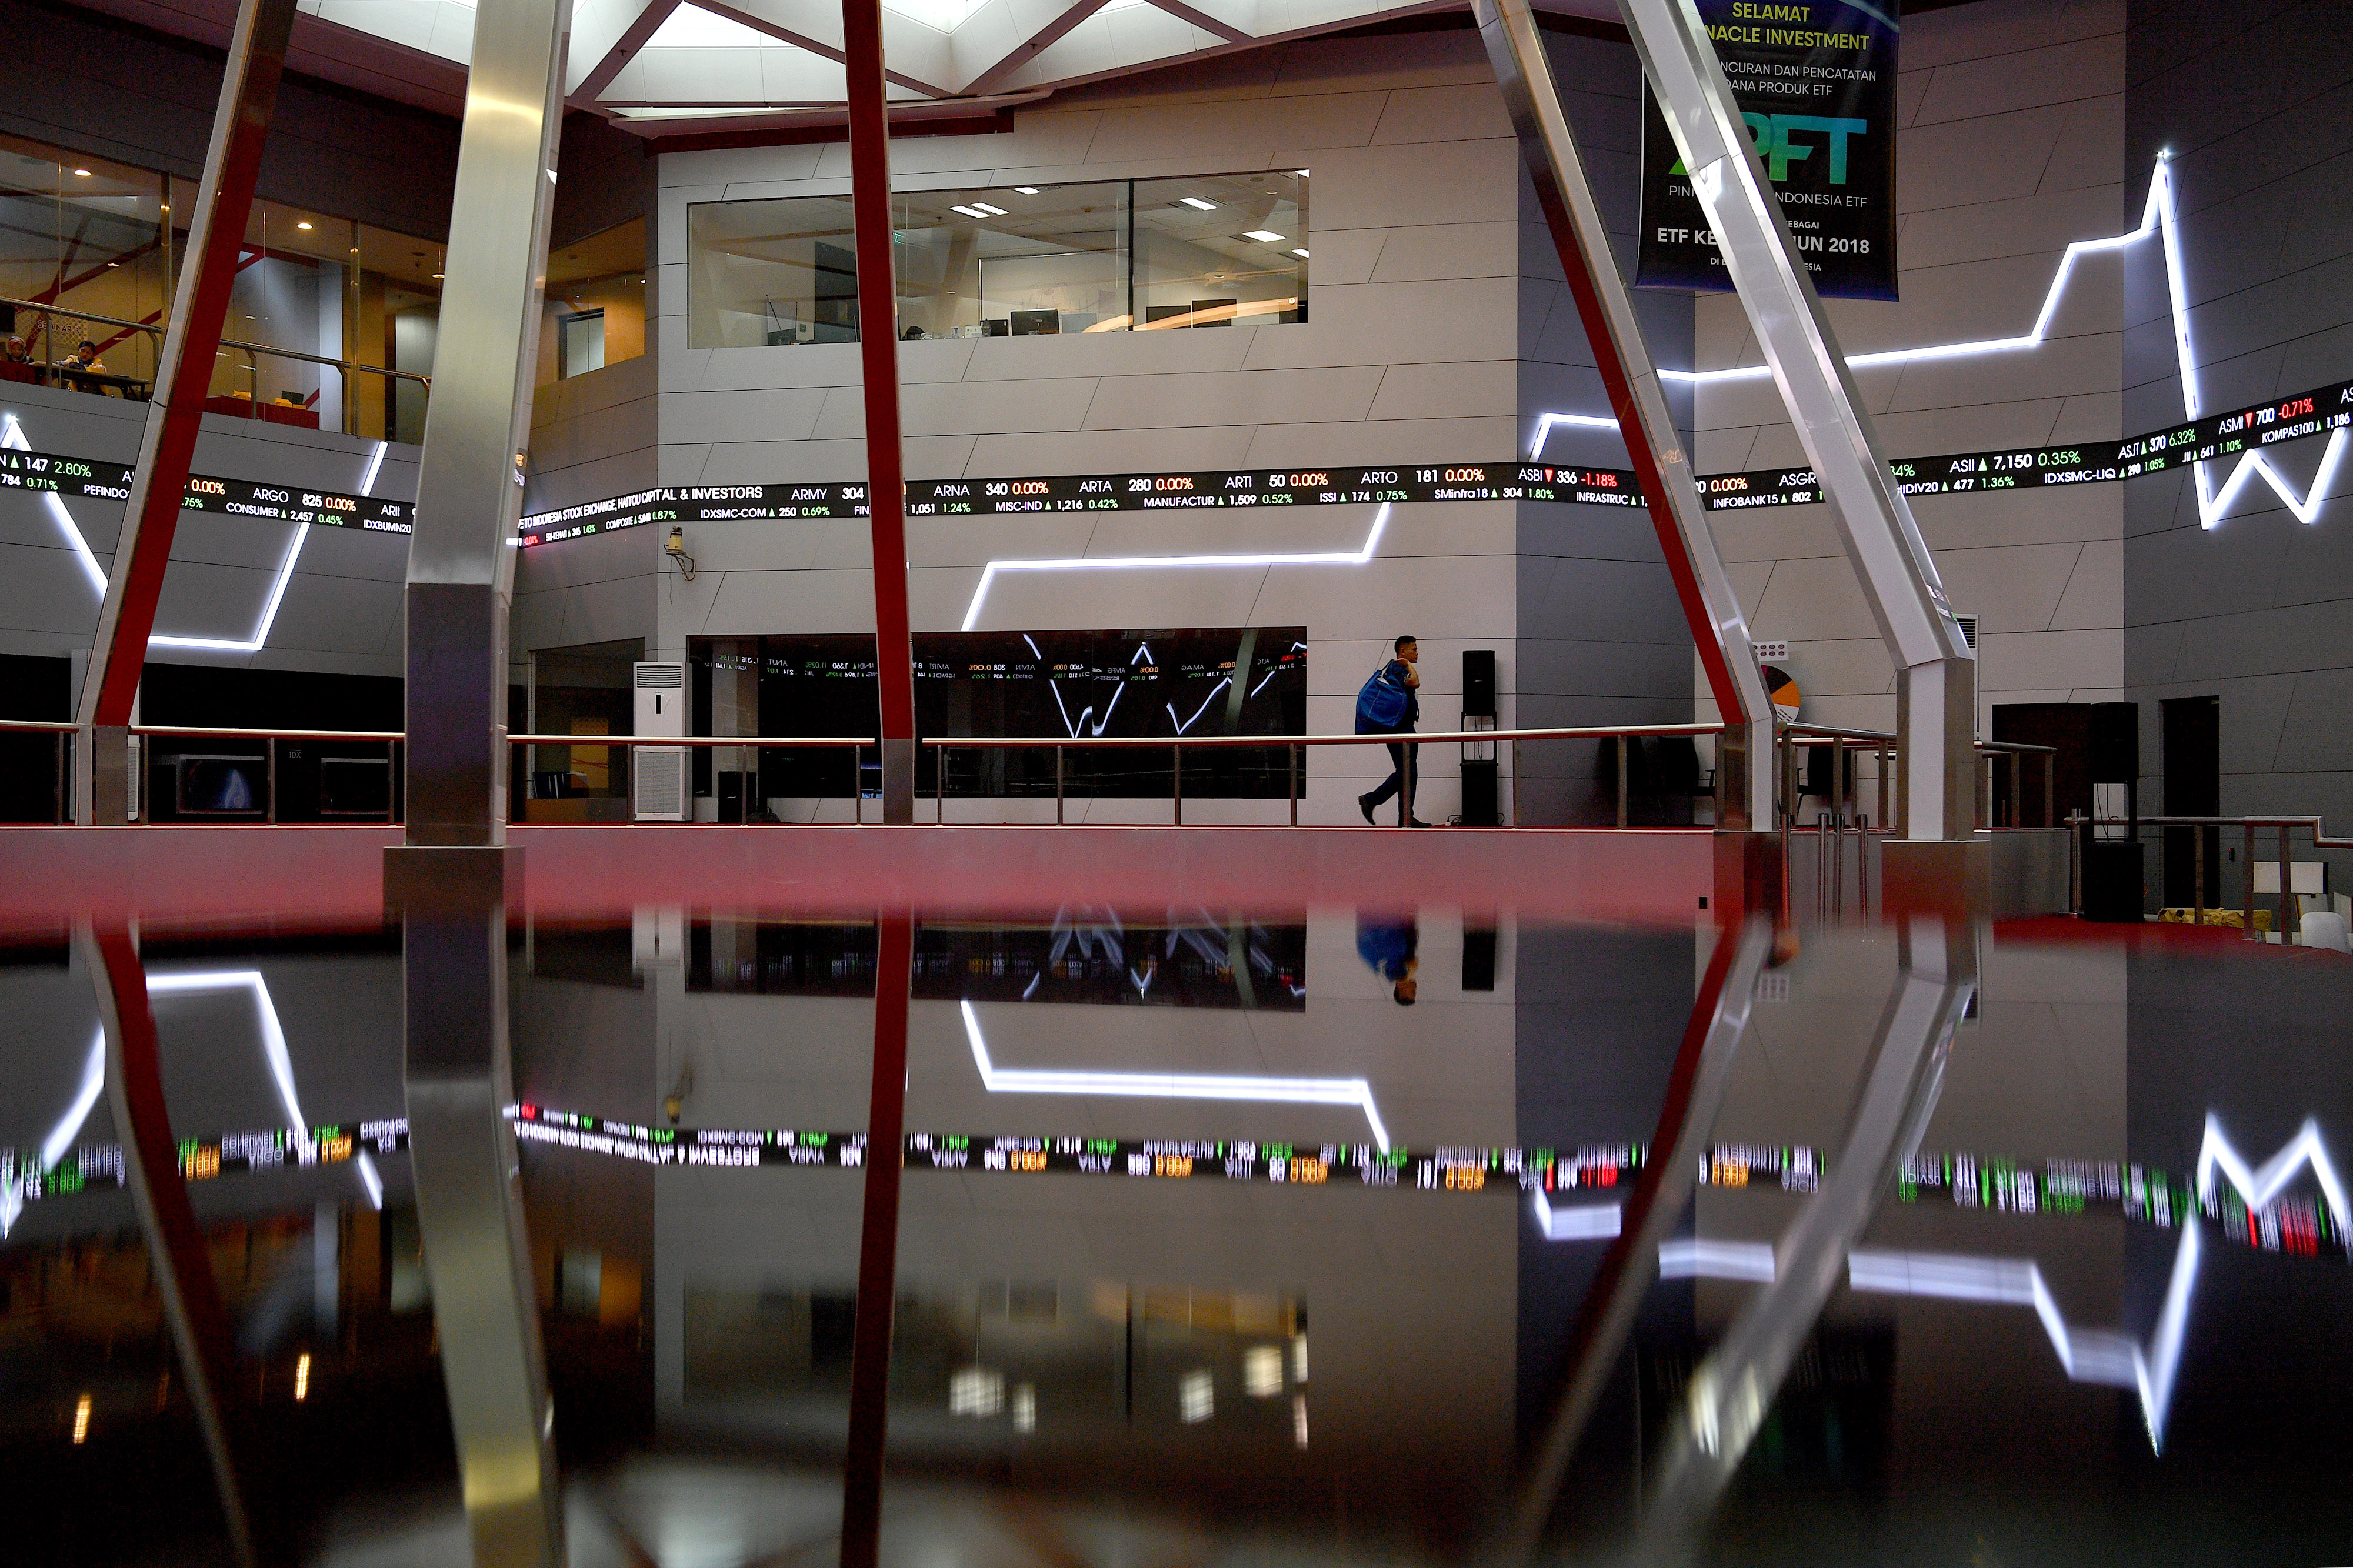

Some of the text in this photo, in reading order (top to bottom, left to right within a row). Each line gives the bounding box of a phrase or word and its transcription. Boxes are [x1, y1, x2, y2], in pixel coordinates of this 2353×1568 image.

[1732, 2, 1810, 22] SELAMAT
[1705, 25, 1870, 51] NACLE INVESTMENT
[1720, 61, 1876, 81] NCURAN DAN PENCATATAN
[1759, 81, 1809, 95] PRODUK
[1813, 85, 1832, 96] ETF
[1669, 185, 1867, 207] PIN NDONESIA ETF
[1786, 220, 1819, 229] EBAGAI
[1658, 228, 1869, 253] ETF KE UN 2018
[2219, 416, 2244, 435] ASMI
[2255, 407, 2275, 425] 700
[2278, 398, 2314, 419] -0.71%
[2262, 412, 2351, 443] KOMPAS100 1,186
[1949, 428, 2196, 473] ASII 7,150 0.35% ASJT 370 6.32%
[25, 456, 48, 472] 147
[54, 461, 92, 478] 2.80%
[1953, 479, 1974, 490] 477
[1982, 476, 2015, 488] 1.36%
[2044, 468, 2116, 483] IDXSMC-LIQ
[2128, 463, 2141, 476] 290
[2145, 457, 2165, 472] 1.05%
[2182, 451, 2191, 463] JII
[2200, 445, 2214, 459] 641
[2219, 439, 2242, 453] 1.10%
[1, 473, 21, 486] 784
[26, 477, 58, 490] 0.71%
[791, 487, 864, 500] ARMY 304
[933, 468, 1617, 497] ARNA 340 0.00% ARTA 280 0.00% ARTI 50 0.00% ARTO 181 0.00% ASBI 336 -1.18%
[1711, 478, 1748, 492] 0.00%
[1779, 472, 1817, 486] ASGR
[191, 479, 226, 495] 0.00%
[252, 488, 289, 503] ARGO
[302, 493, 323, 508] 825
[325, 496, 356, 512] 0.00%
[381, 504, 401, 517] ARII
[524, 516, 533, 528] TO
[563, 505, 584, 521] STOCK
[583, 499, 617, 516] EXCHANGE,
[618, 495, 641, 509] HAITOU
[641, 489, 677, 505] CAPITAL
[680, 489, 689, 500] &
[691, 486, 763, 500] INVESTORS
[911, 504, 935, 515] 1,051
[943, 503, 971, 513] 1.24%
[995, 502, 1042, 511] MISC-IND
[1057, 500, 1083, 510] 1,216
[1088, 499, 1118, 509] 0.42%
[1144, 496, 1215, 507] MANUFACTUR
[1229, 495, 1257, 505] 1,509
[1262, 493, 1293, 504] 0.52%
[1320, 492, 1337, 502] ISSI
[1352, 491, 1371, 502] 174
[1376, 491, 1408, 501] 0.75%
[1434, 488, 1488, 499] SMinfra18
[1502, 487, 1523, 498] 304
[1528, 488, 1554, 499] 1.80%
[1577, 492, 1628, 505] INFRASTRUC
[1713, 494, 1778, 508] INFOBANK15
[1792, 492, 1811, 502] 802
[181, 496, 412, 533] .75% CONSUMER 2,457 0.45% IDXBUMN20
[605, 516, 634, 529] COMPOSITE
[652, 511, 677, 520] 0.87%
[700, 508, 766, 519] IDXSMC-COM
[778, 507, 796, 517] 250
[802, 506, 831, 516] 0.69%
